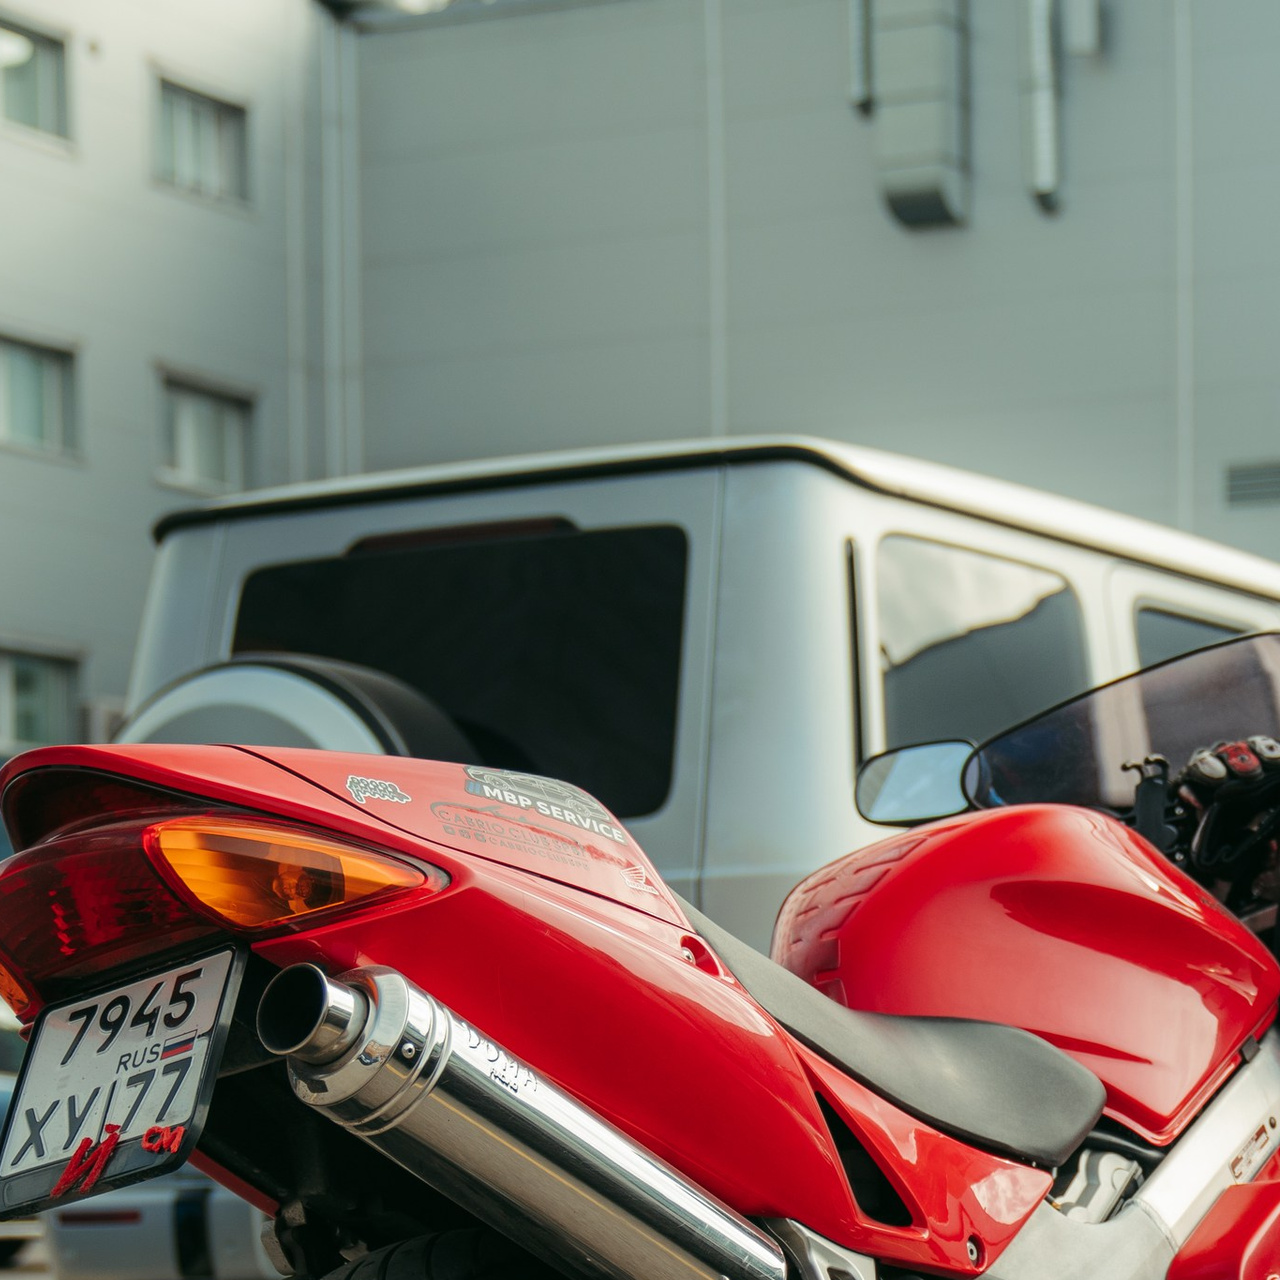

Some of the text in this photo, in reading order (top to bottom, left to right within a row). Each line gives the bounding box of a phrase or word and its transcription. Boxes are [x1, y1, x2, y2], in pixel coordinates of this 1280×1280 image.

[438, 808, 506, 834] CABRIO
[482, 783, 626, 844] MBP SERVICE
[60, 966, 204, 1066] 7945
[115, 1042, 162, 1074] RUS
